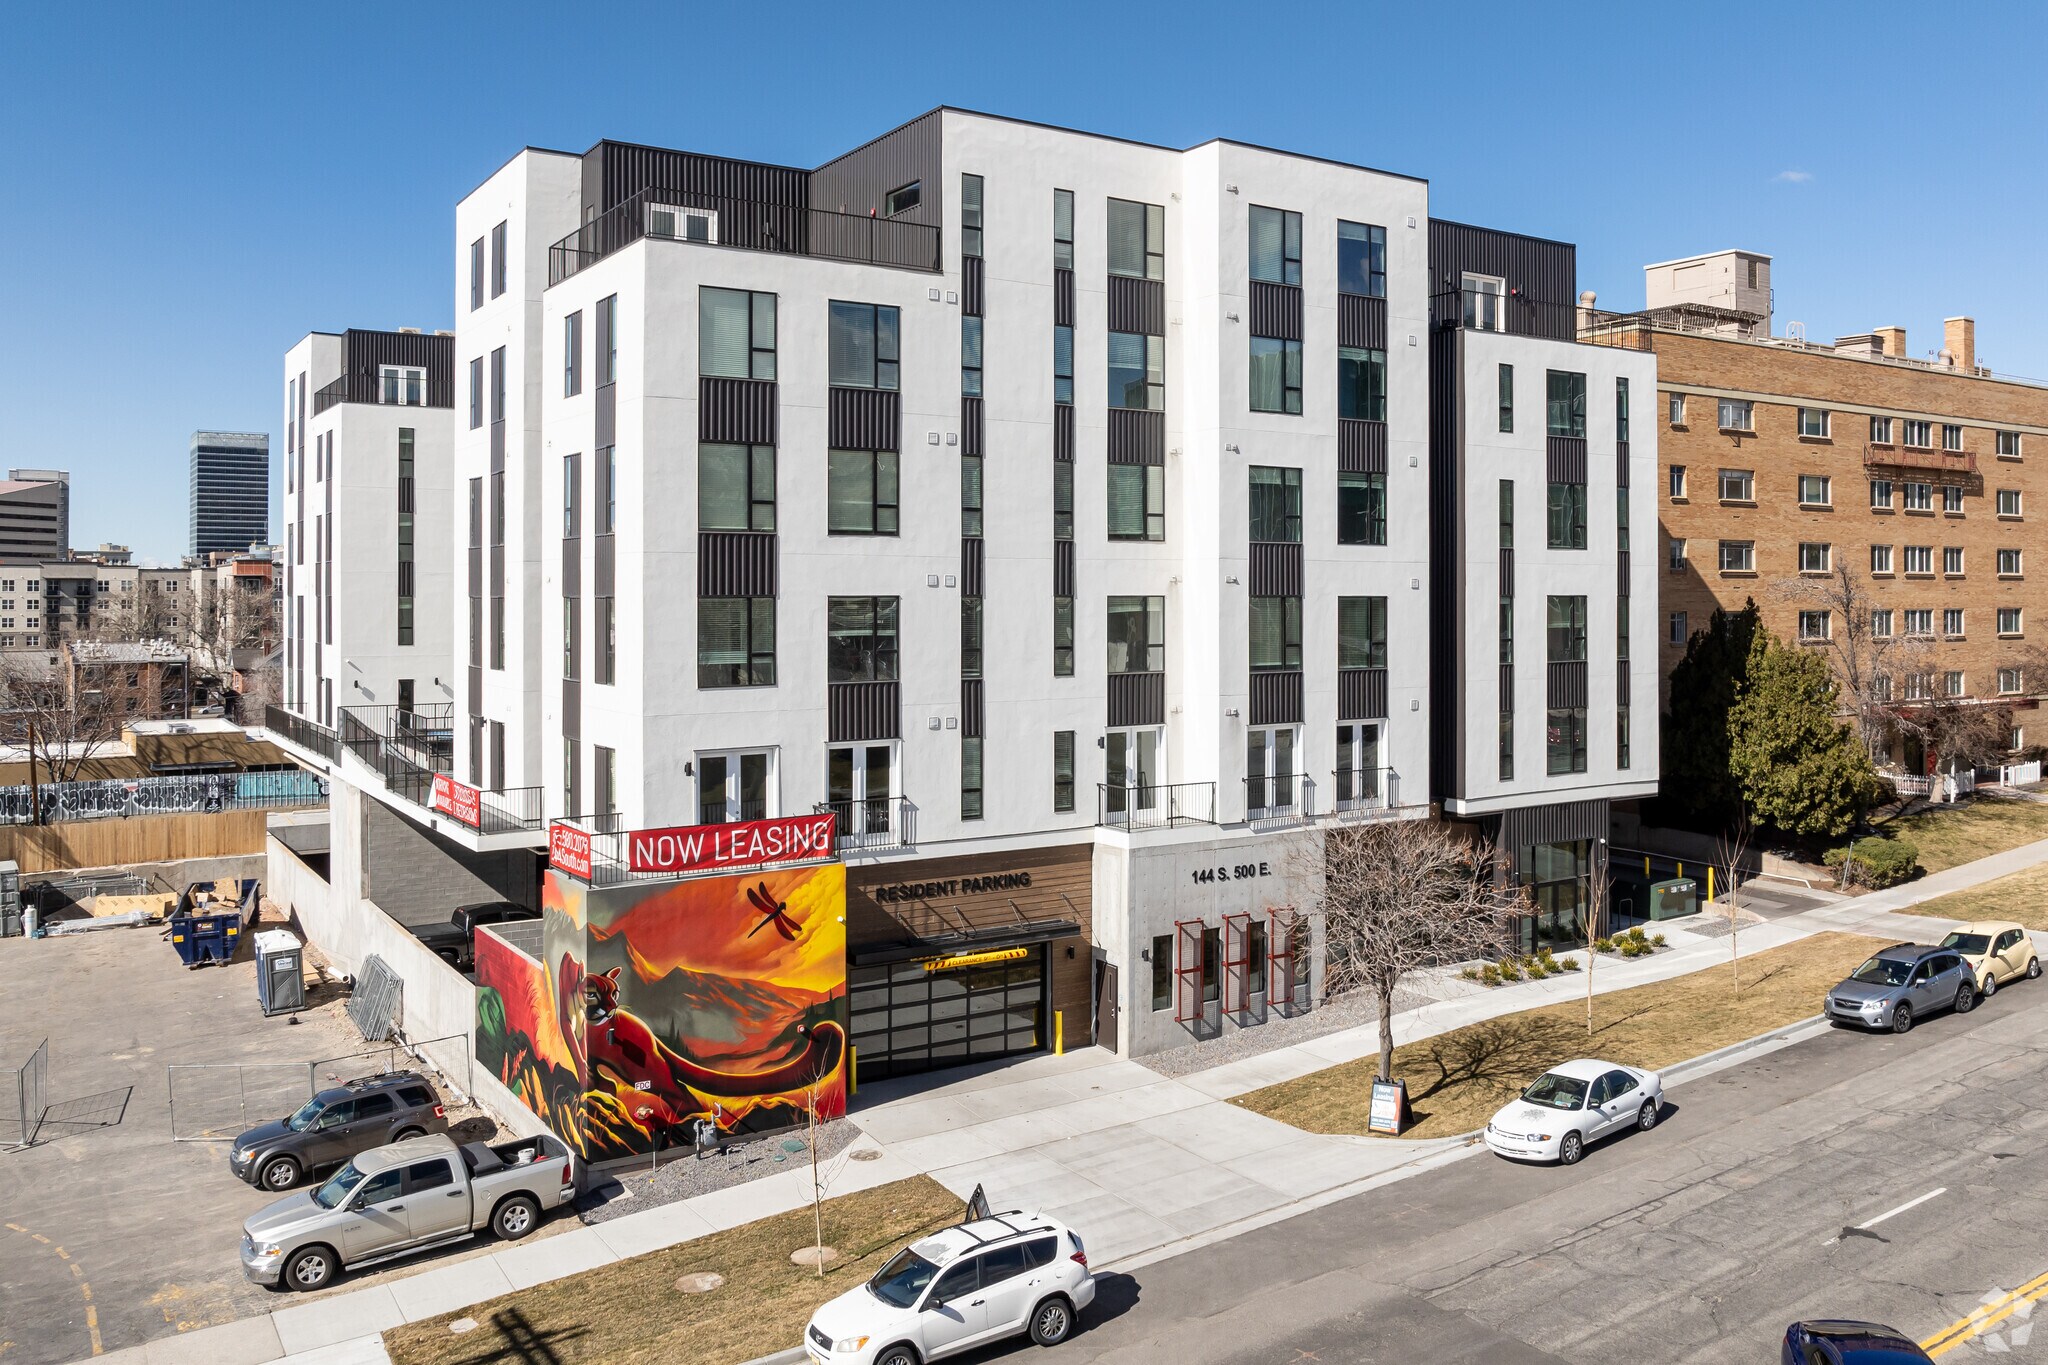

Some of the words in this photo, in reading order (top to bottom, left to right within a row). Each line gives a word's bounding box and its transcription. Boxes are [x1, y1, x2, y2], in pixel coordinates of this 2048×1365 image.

[636, 834, 704, 868] NOW
[715, 821, 829, 861] LEASING
[1192, 868, 1215, 885] 144
[1217, 867, 1230, 882] S.
[1234, 864, 1256, 880] 500
[1259, 862, 1272, 877] E.
[876, 880, 957, 904] RESIDENT
[961, 871, 1032, 895] PARKING
[635, 1081, 650, 1090] FDC
[1378, 1085, 1392, 1093] Now
